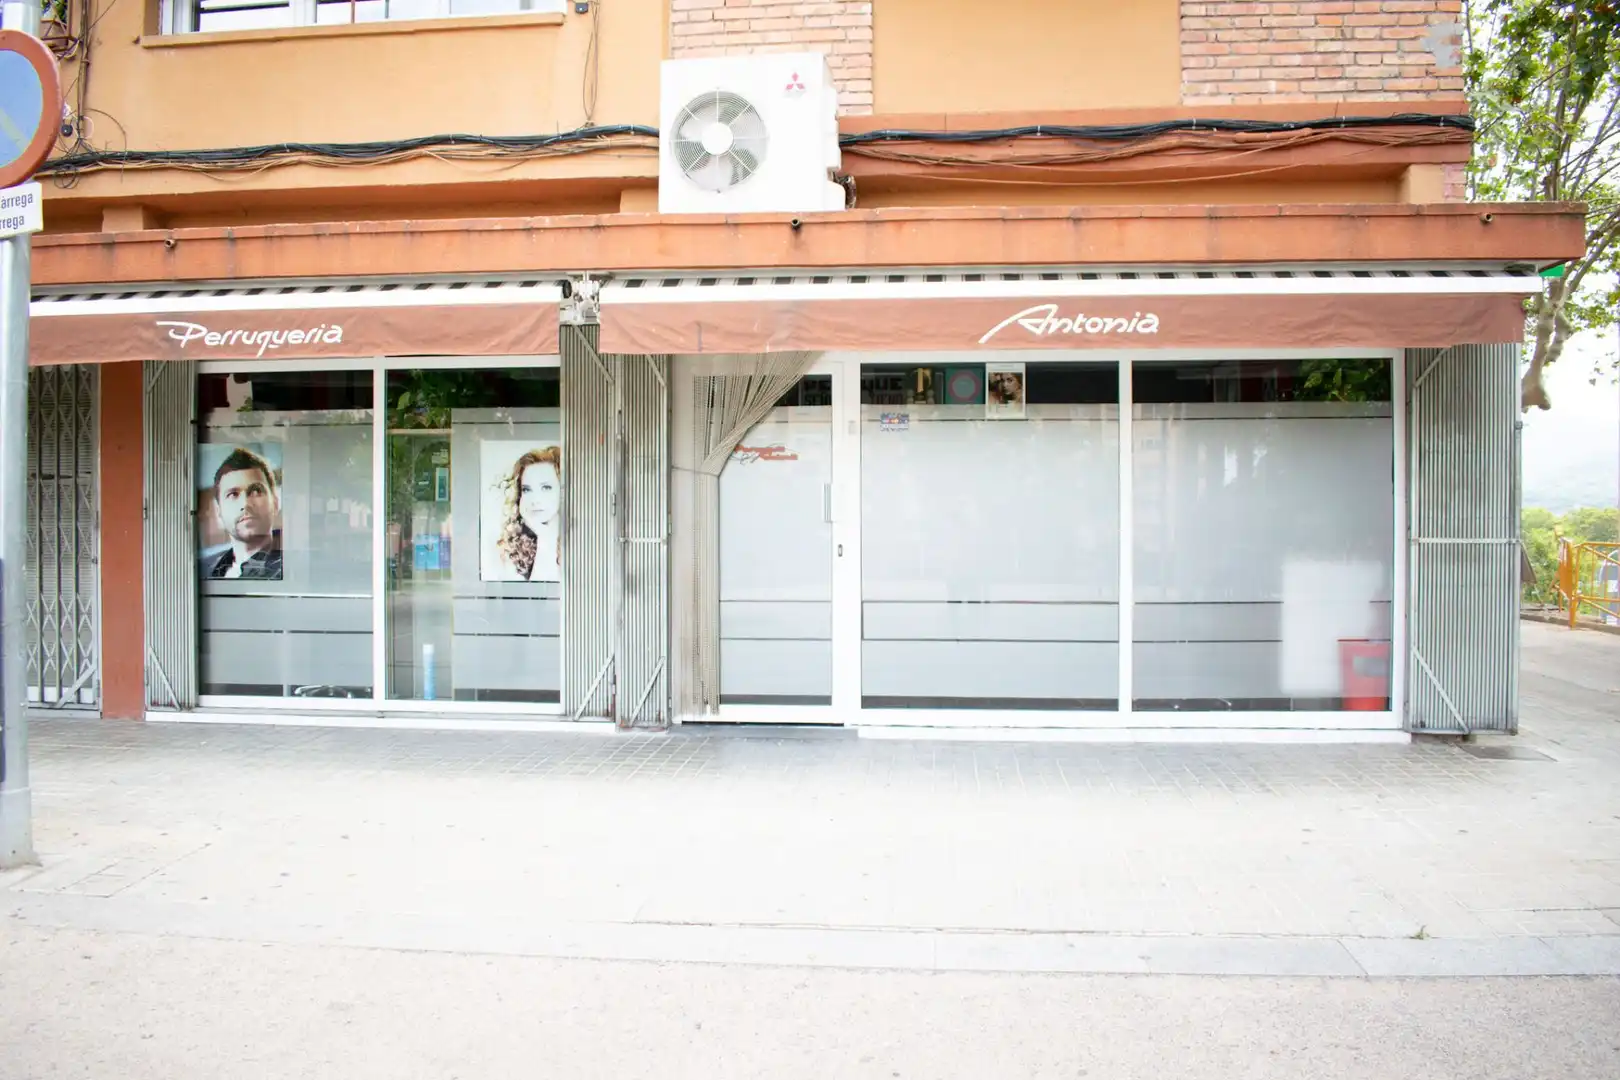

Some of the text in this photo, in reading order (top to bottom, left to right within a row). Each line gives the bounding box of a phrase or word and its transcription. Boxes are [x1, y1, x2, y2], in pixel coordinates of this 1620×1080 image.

[0, 193, 33, 209] àrrega
[0, 215, 25, 230] rrega
[978, 304, 1160, 344] Antonia
[156, 321, 343, 358] Perruqueria
